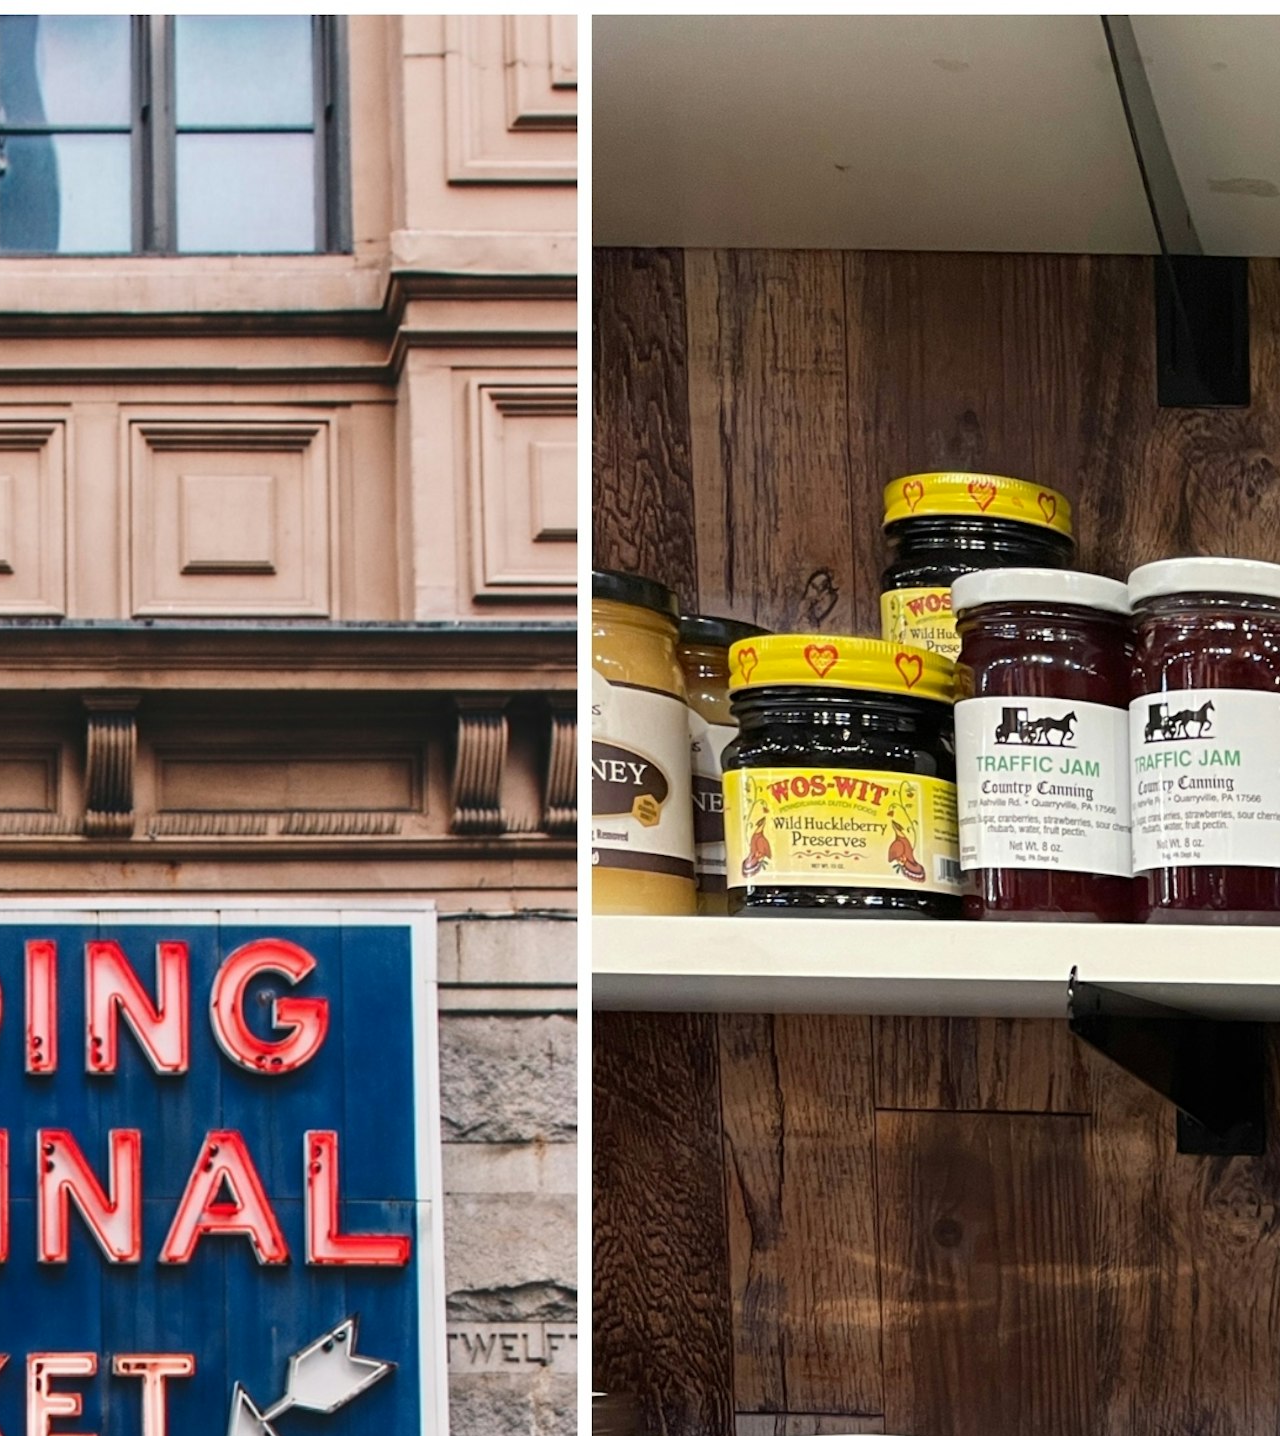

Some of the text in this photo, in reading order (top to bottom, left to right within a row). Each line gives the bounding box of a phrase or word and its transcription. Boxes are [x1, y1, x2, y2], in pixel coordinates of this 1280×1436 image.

[910, 628, 936, 640] Wild
[976, 756, 1100, 777] TRAFFIC JAM
[1135, 749, 1241, 772] TRAFFIC JAM
[767, 775, 890, 806] WOS-WIT
[981, 780, 1094, 801] Country Canning
[1178, 775, 1234, 792] Canning
[1221, 793, 1232, 803] PA
[1235, 793, 1261, 803] 17566
[774, 815, 888, 836] Wild Huckleberry
[792, 832, 867, 849] Preserves
